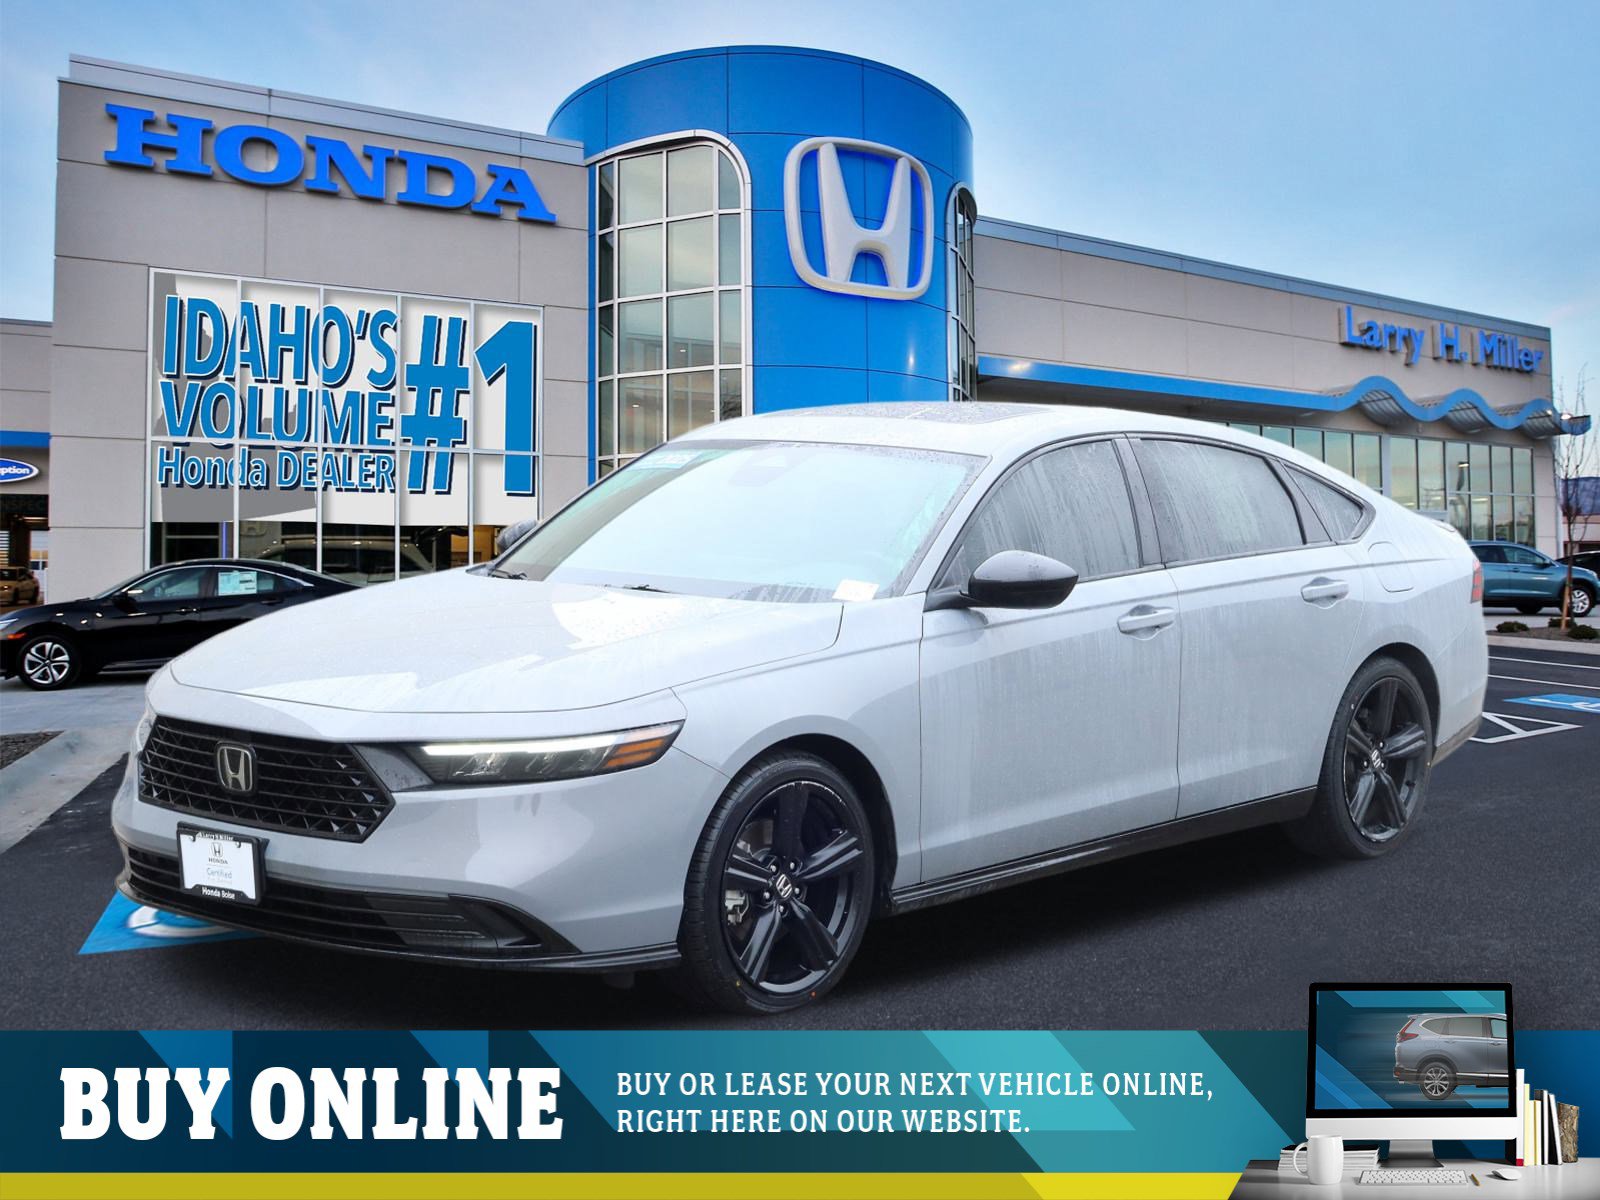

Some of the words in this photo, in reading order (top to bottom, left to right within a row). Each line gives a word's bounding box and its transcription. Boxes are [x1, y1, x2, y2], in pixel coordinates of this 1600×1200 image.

[104, 102, 558, 224] HONDA
[162, 293, 399, 388] IDAHO'S
[1340, 304, 1424, 366] Larry
[1435, 321, 1468, 362] H.
[1474, 329, 1545, 373] Miller
[158, 380, 398, 448] VOLUME
[399, 314, 540, 496] #1
[0, 465, 30, 476] ption
[156, 445, 269, 490] Honda
[276, 450, 397, 493] DEALER
[201, 886, 221, 898] Honda
[208, 857, 229, 865] HONDA
